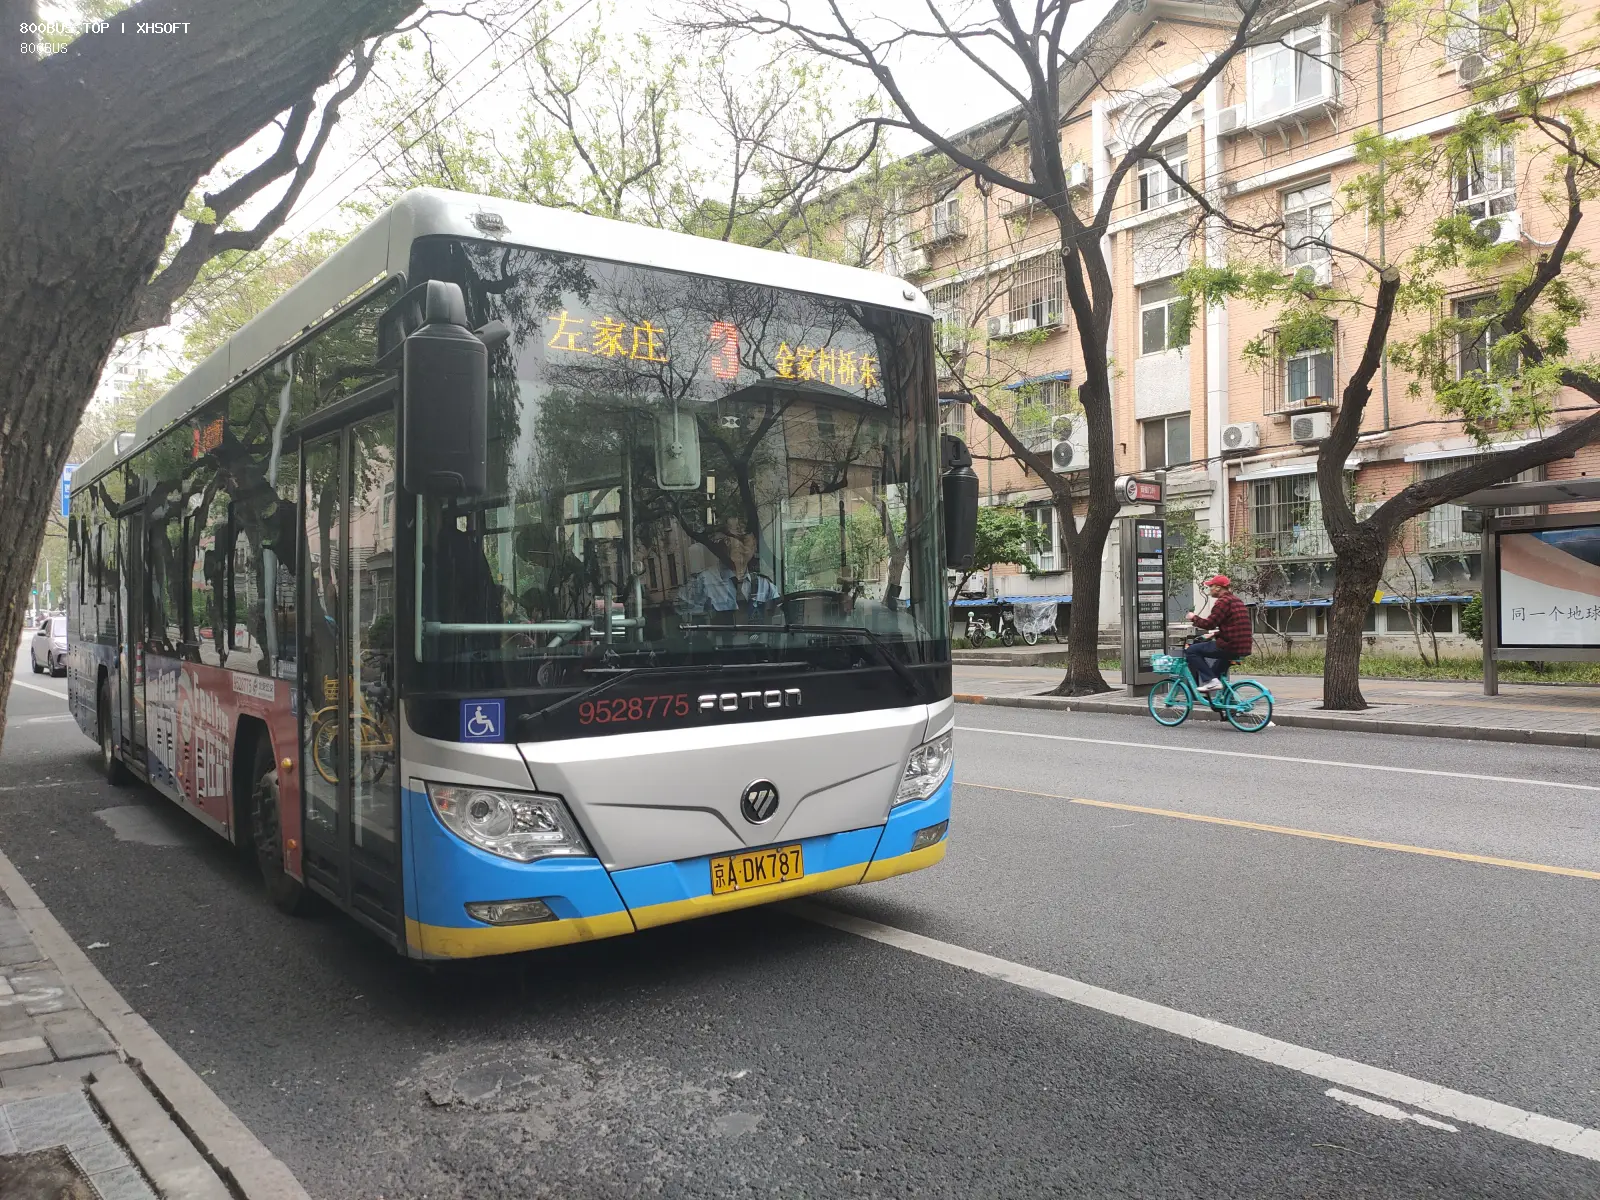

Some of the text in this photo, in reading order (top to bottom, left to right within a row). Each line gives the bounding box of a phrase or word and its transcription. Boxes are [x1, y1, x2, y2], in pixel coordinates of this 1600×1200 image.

[548, 310, 668, 363] 左家庄
[710, 321, 739, 379] 3
[1511, 604, 1600, 621] 同一个地球
[578, 687, 802, 724] 9528775 FOTON
